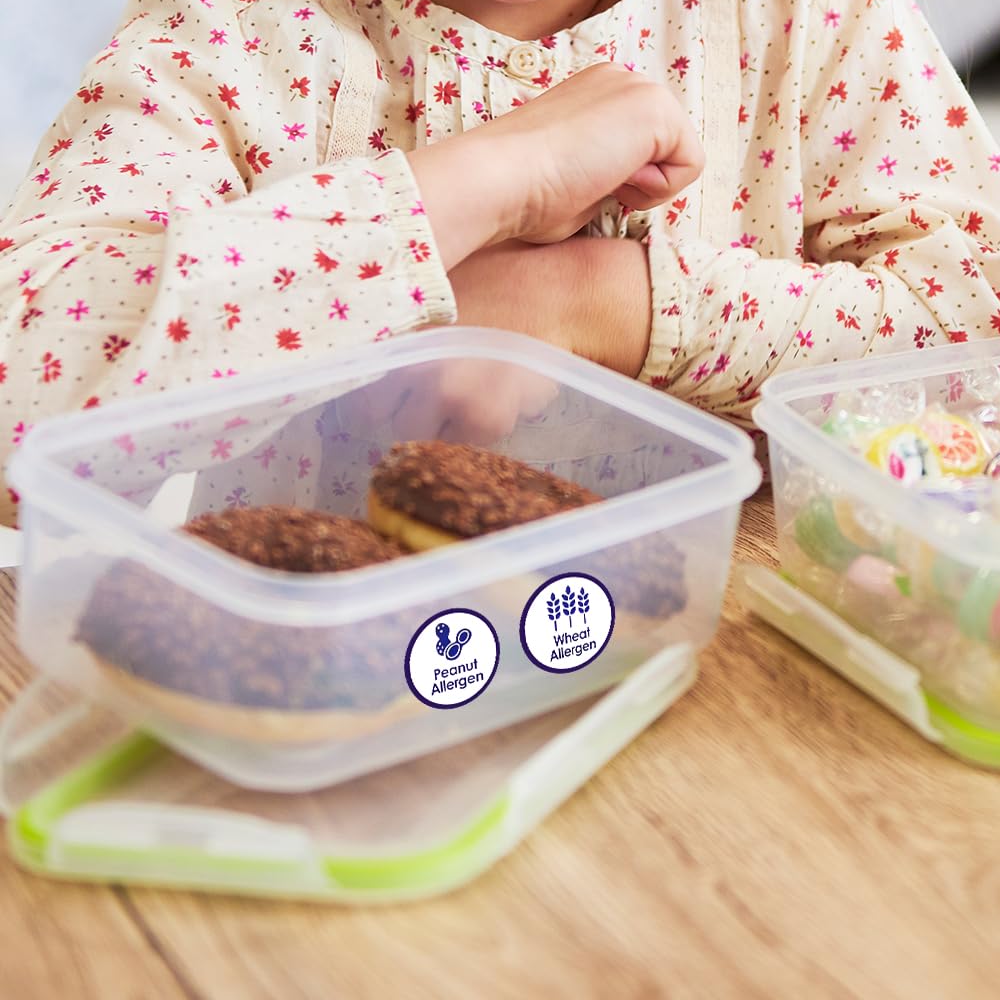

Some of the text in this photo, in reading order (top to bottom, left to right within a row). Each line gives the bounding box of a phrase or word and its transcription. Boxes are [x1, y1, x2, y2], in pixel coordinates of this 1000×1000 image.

[553, 627, 591, 648] Wheat
[550, 639, 597, 662] Allergen
[433, 658, 478, 681] Peanut
[431, 671, 484, 697] Allergen
